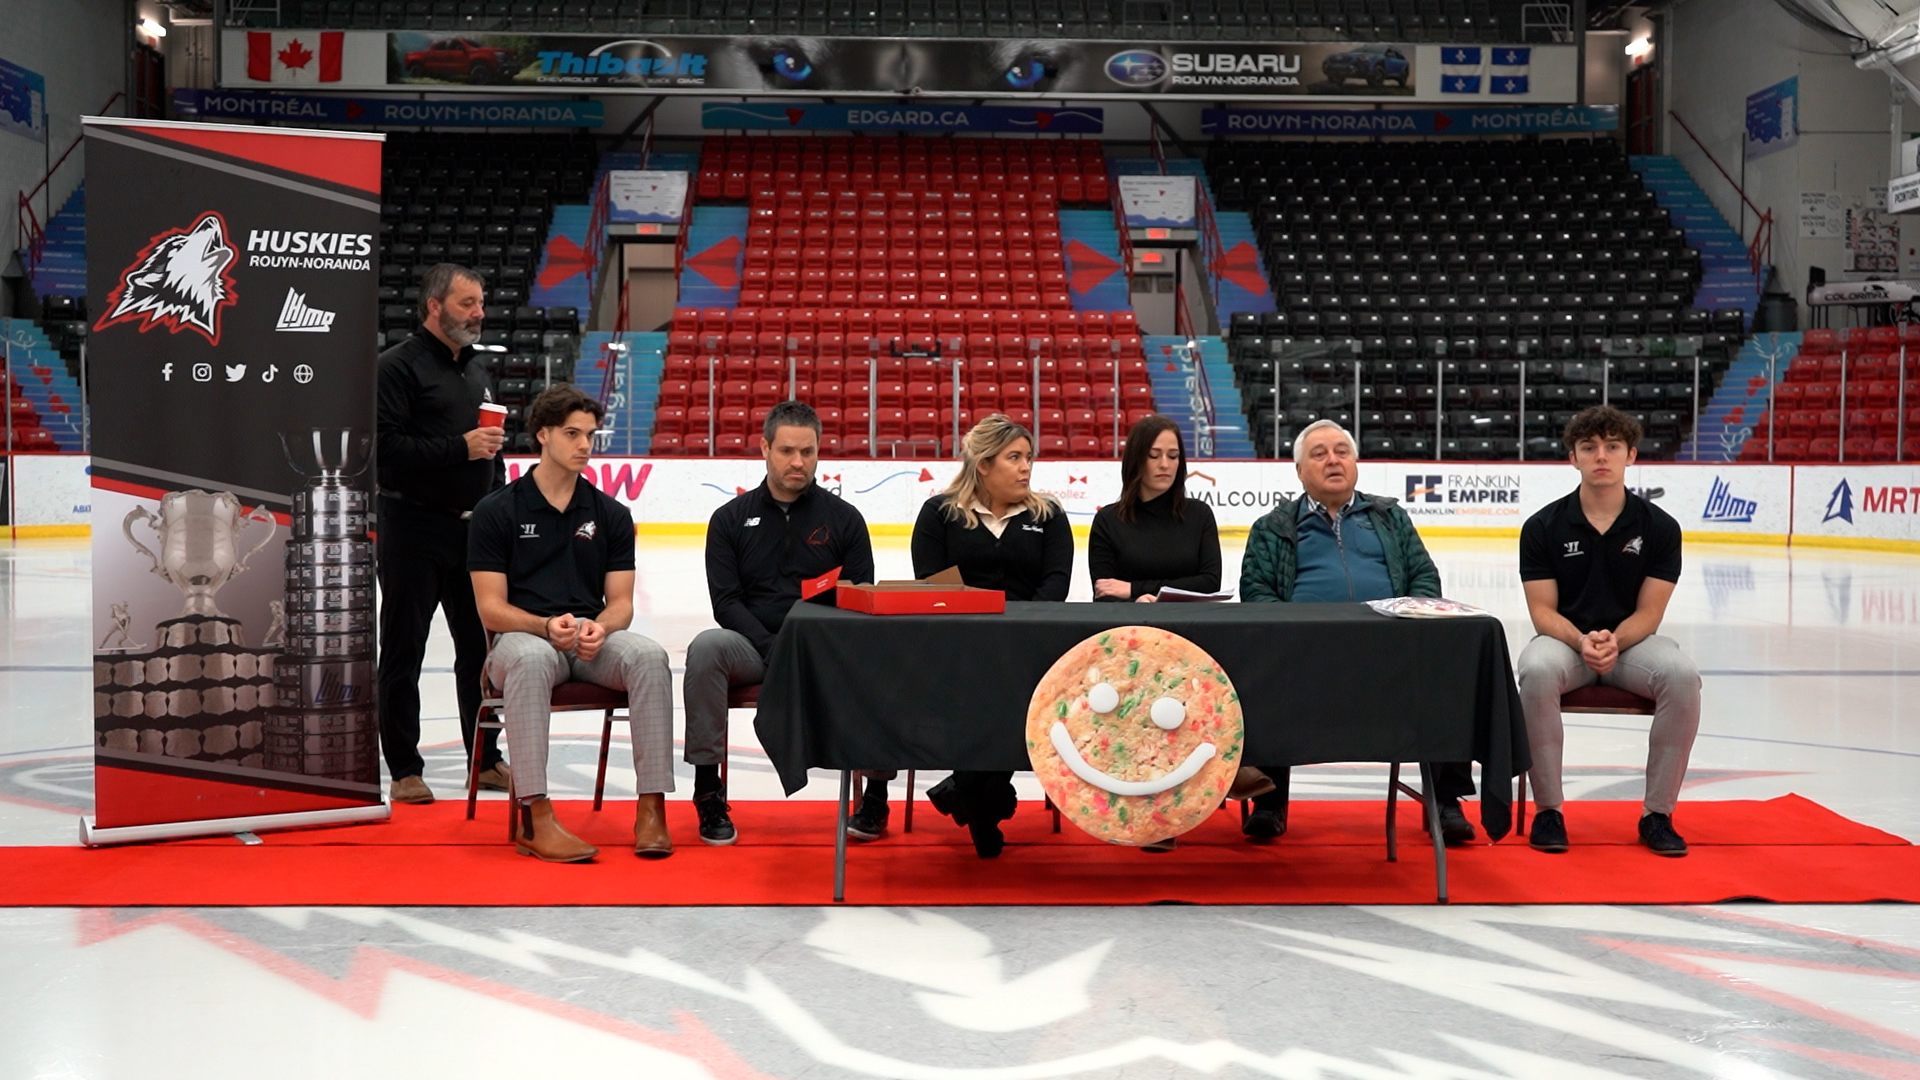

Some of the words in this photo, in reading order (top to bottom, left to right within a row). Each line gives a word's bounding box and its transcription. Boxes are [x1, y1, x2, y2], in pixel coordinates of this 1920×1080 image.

[537, 50, 708, 76] Thibault
[1172, 53, 1300, 73] SUBARU
[536, 76, 599, 84] CHEVROLET
[1172, 75, 1300, 86] ROUYN-NORANDA
[204, 96, 328, 117] MONTRÉAL
[384, 104, 576, 121] ROUYN-NORANDA
[847, 109, 970, 126] EDGARD.CA
[1228, 114, 1417, 130] ROUYN-NORANDA
[1472, 109, 1592, 129] MONTRÉAL
[247, 229, 373, 256] HUSKIES
[249, 255, 371, 271] ROUYN-NORANDA
[1824, 292, 1890, 301] COLORMAX
[1448, 475, 1520, 488] FRANKLIN
[1448, 489, 1520, 503] EMPIRE
